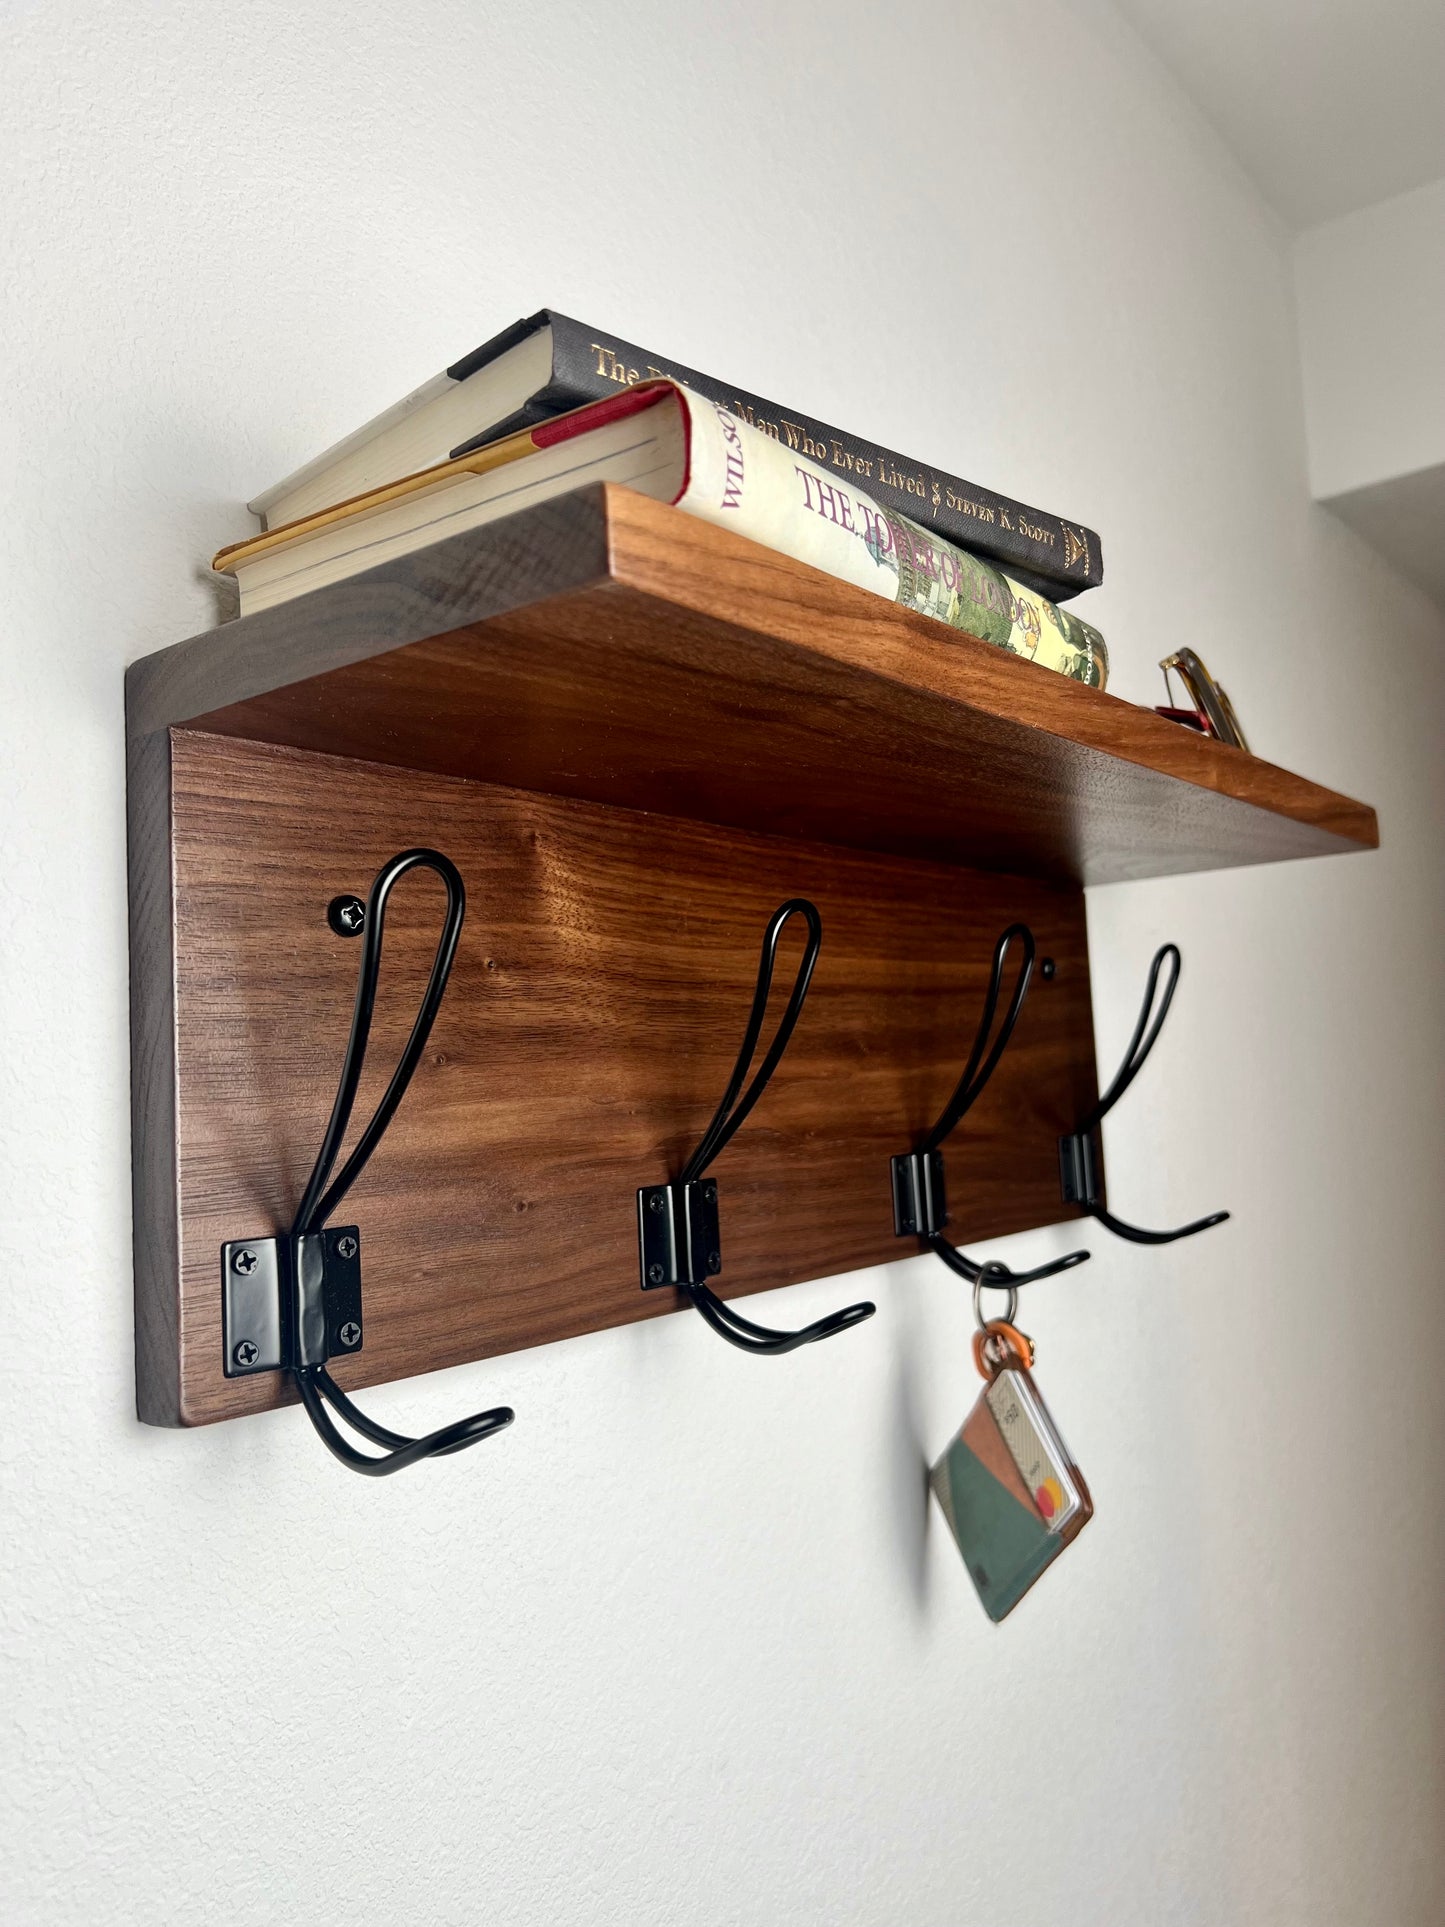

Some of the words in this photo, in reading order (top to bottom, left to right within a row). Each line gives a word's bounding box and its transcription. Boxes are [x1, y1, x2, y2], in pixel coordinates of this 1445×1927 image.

[591, 343, 640, 386] The
[734, 400, 780, 439] Man
[780, 419, 827, 459] Who
[829, 438, 873, 478] Ever
[876, 457, 926, 498] Lived
[713, 399, 745, 511] WILSO
[794, 464, 855, 534] THE
[856, 501, 940, 584] TOWER
[940, 551, 963, 593] OF
[968, 567, 1042, 638] LONDON
[998, 506, 1015, 531] K.
